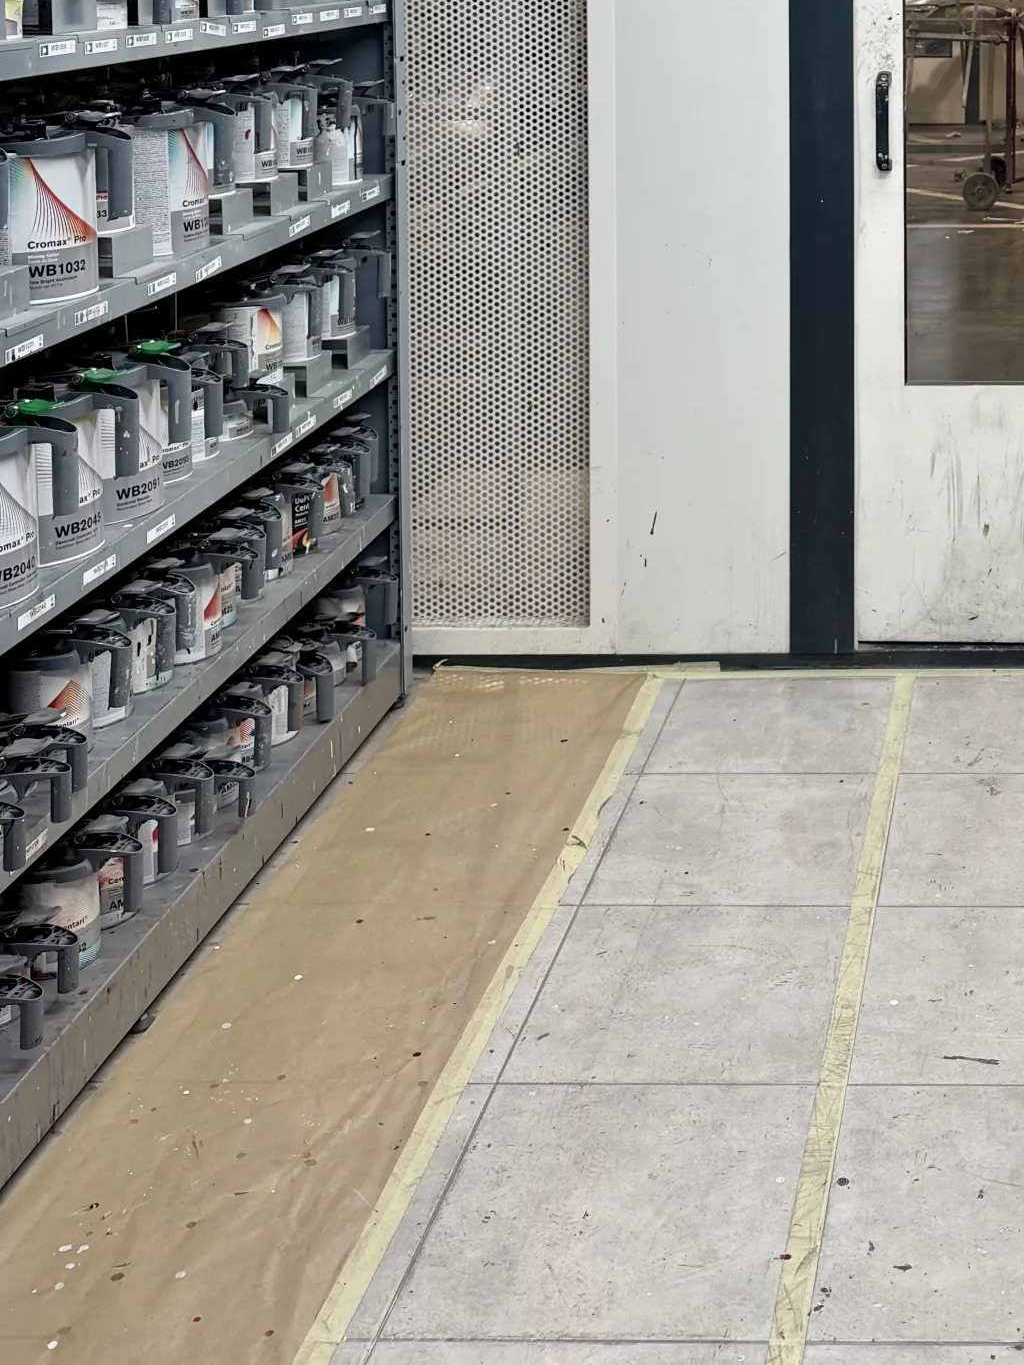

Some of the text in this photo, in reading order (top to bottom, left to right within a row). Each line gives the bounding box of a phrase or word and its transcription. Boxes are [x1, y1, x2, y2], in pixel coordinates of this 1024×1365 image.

[97, 210, 108, 219] 33
[27, 234, 87, 250] Cromax Pro
[28, 259, 86, 279] WB1032
[162, 444, 179, 453] romax
[116, 476, 160, 501] WB2091
[54, 511, 102, 539] WB2045
[0, 530, 35, 552] omax Pro
[0, 555, 36, 582] B2040
[109, 899, 124, 911] AM
